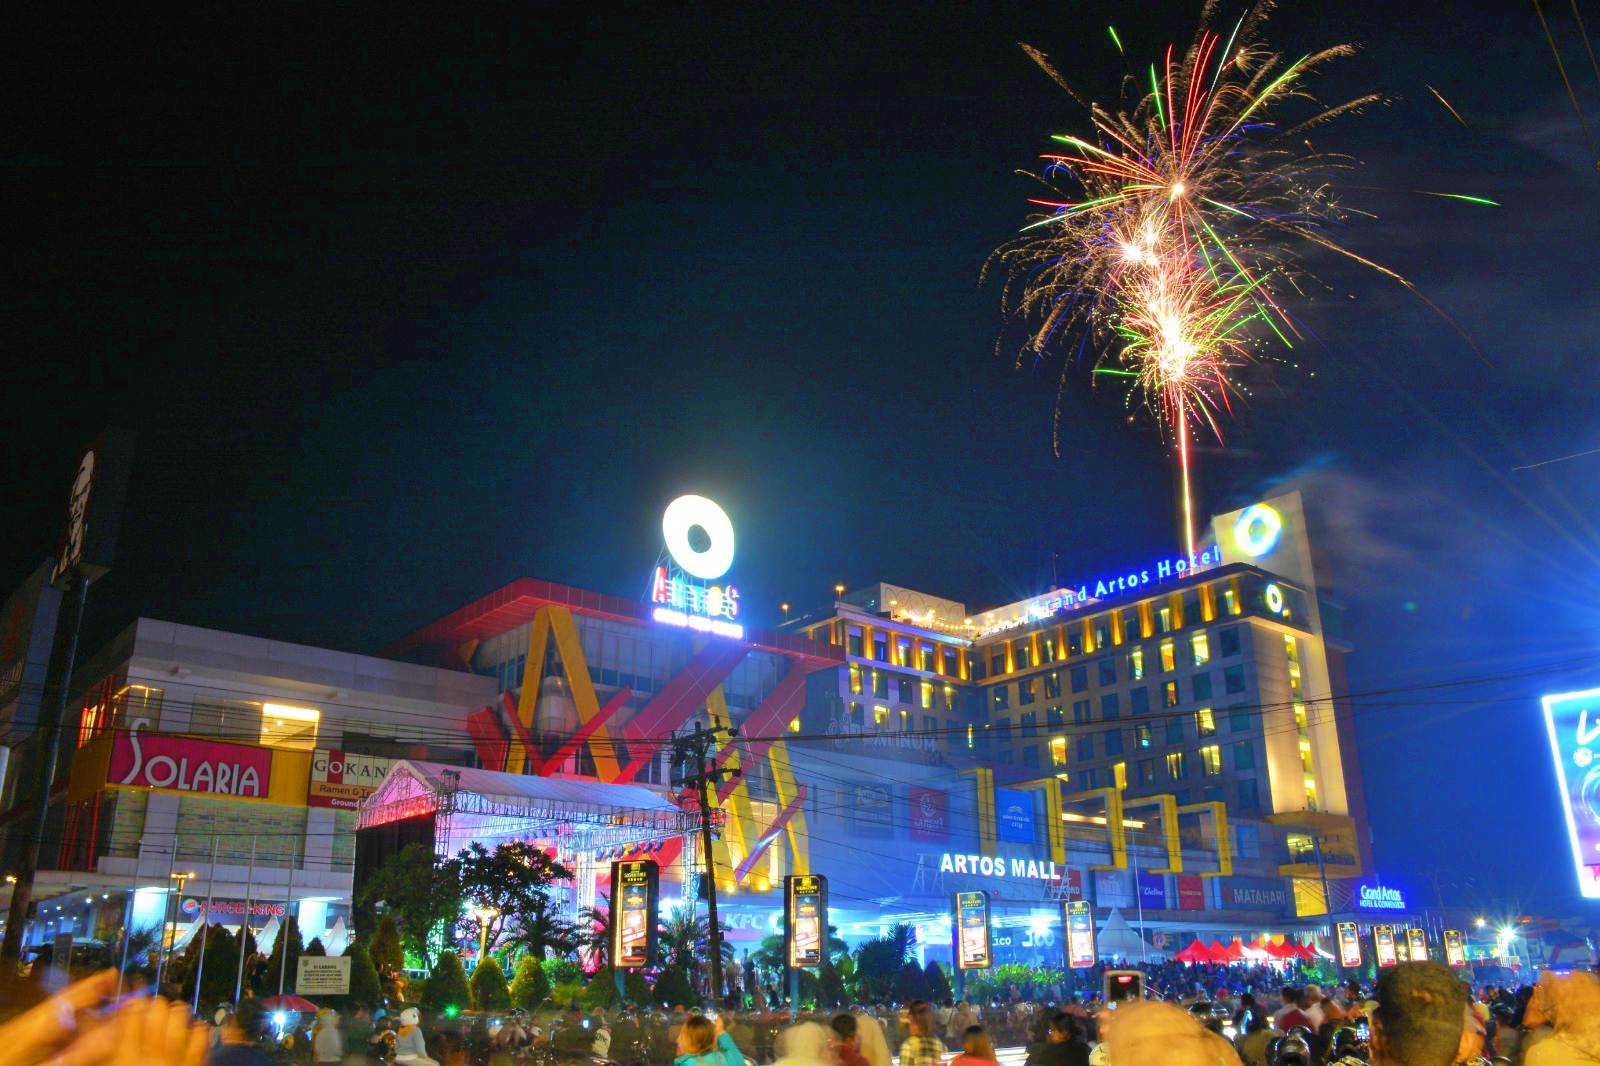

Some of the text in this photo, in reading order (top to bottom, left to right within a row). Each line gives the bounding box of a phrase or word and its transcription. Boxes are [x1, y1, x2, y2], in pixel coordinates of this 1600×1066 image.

[1095, 571, 1149, 598] Artos
[1158, 545, 1222, 578] Hotel
[122, 718, 260, 796] SOLARIA
[314, 759, 387, 779] GOKAN
[320, 785, 350, 796] Ramen
[331, 798, 360, 808] Ground
[940, 853, 1061, 880] ARTOS MALL
[1233, 888, 1286, 904] MATAHARI
[1361, 885, 1401, 901] Grand Artos
[725, 912, 764, 929] KFC
